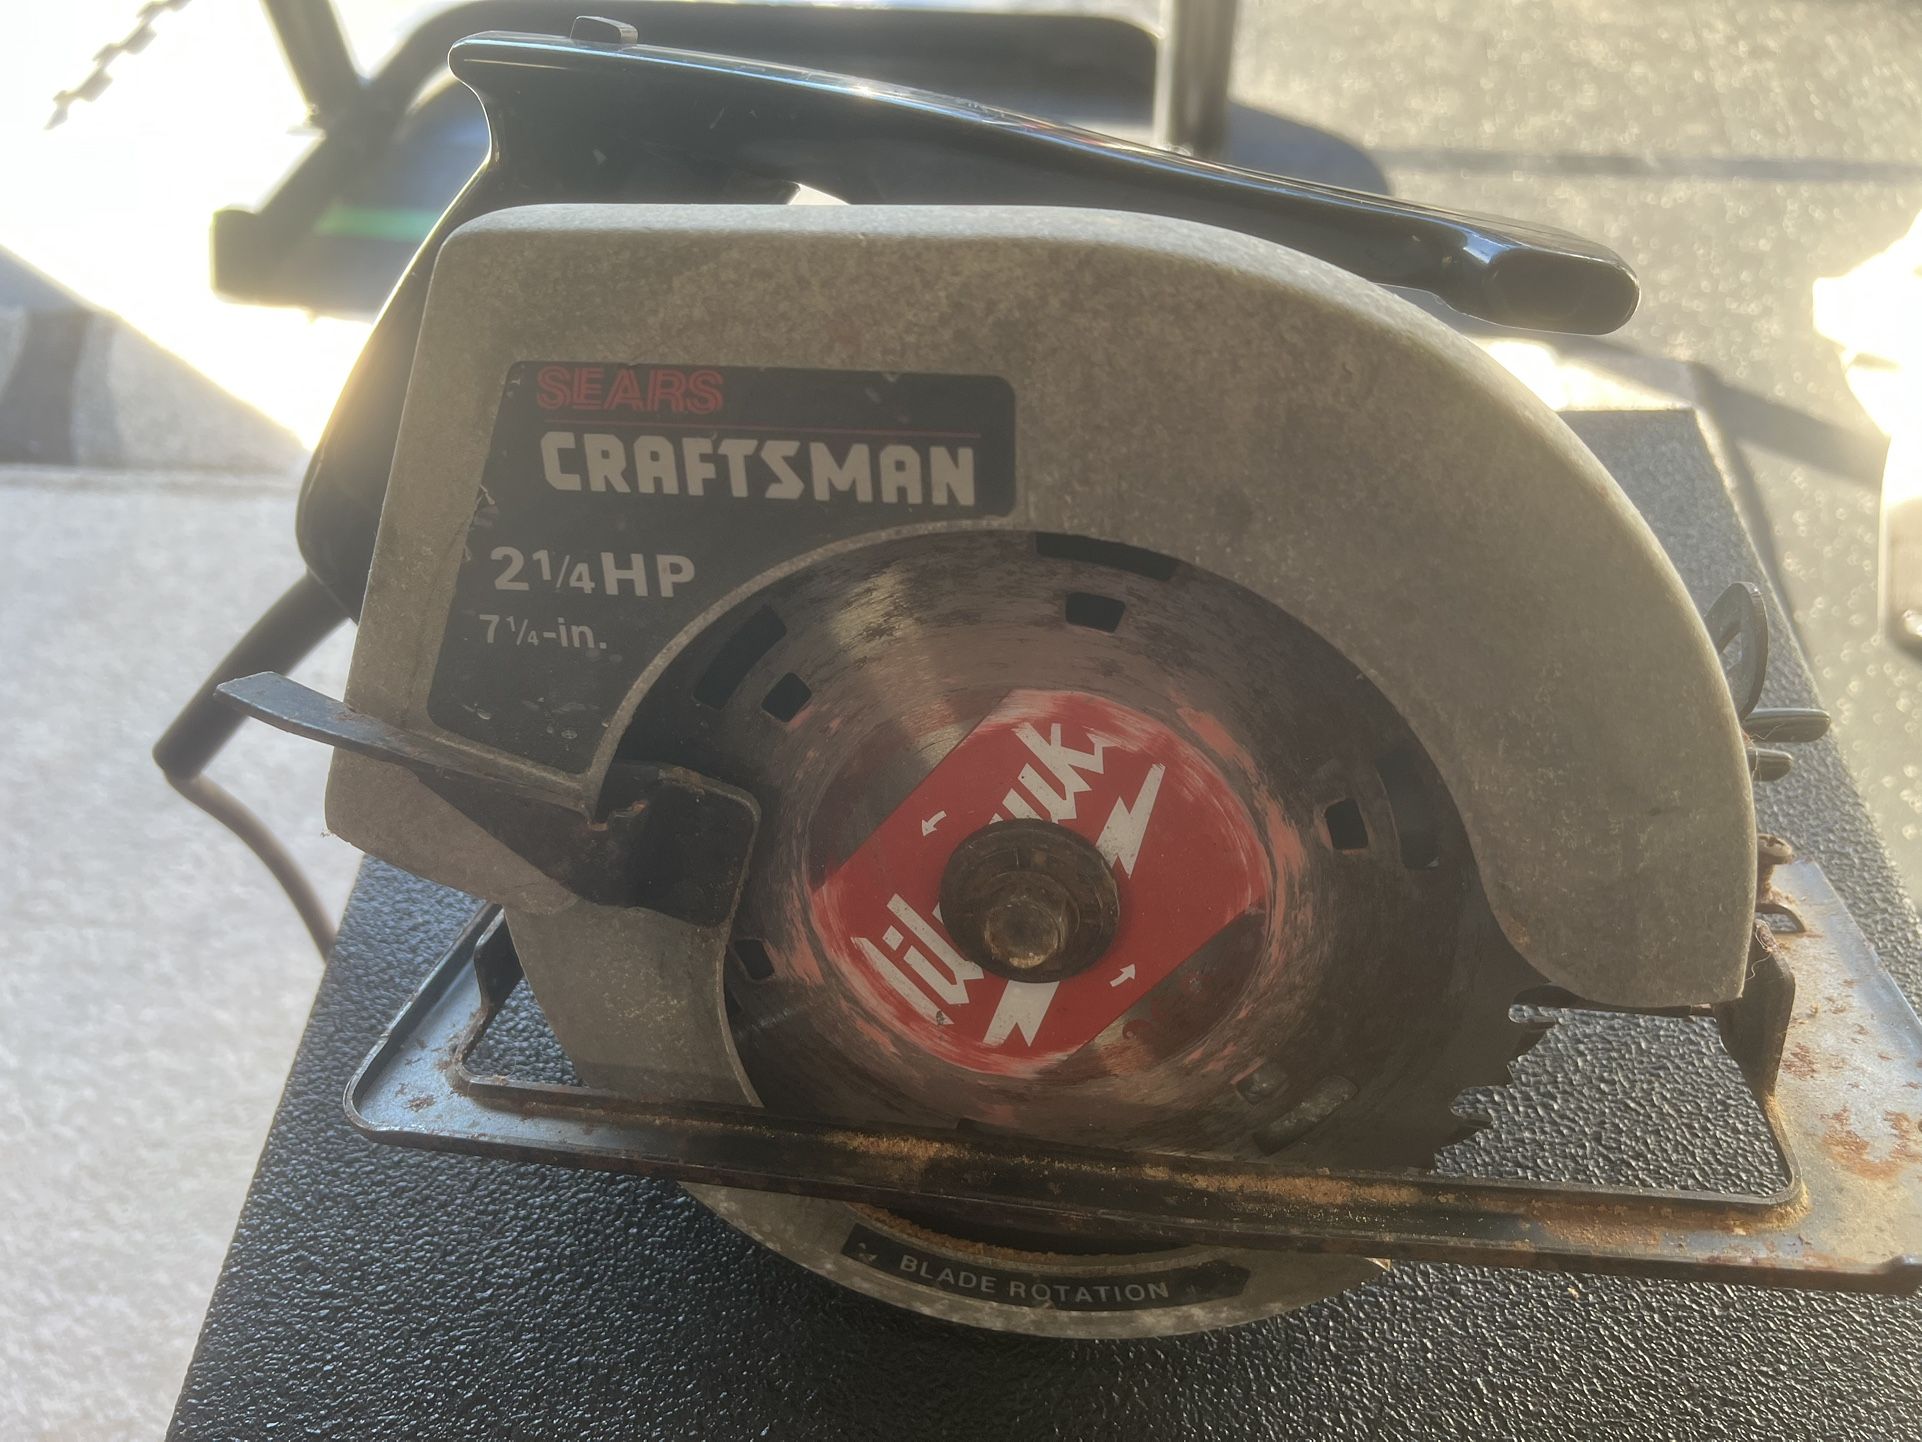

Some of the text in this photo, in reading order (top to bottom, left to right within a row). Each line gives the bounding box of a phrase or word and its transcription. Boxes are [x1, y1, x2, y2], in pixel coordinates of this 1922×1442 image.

[537, 366, 723, 414] SEARS
[540, 431, 976, 506] CRAFTSMAN
[900, 1254, 1168, 1302] BLADE ROTATION
